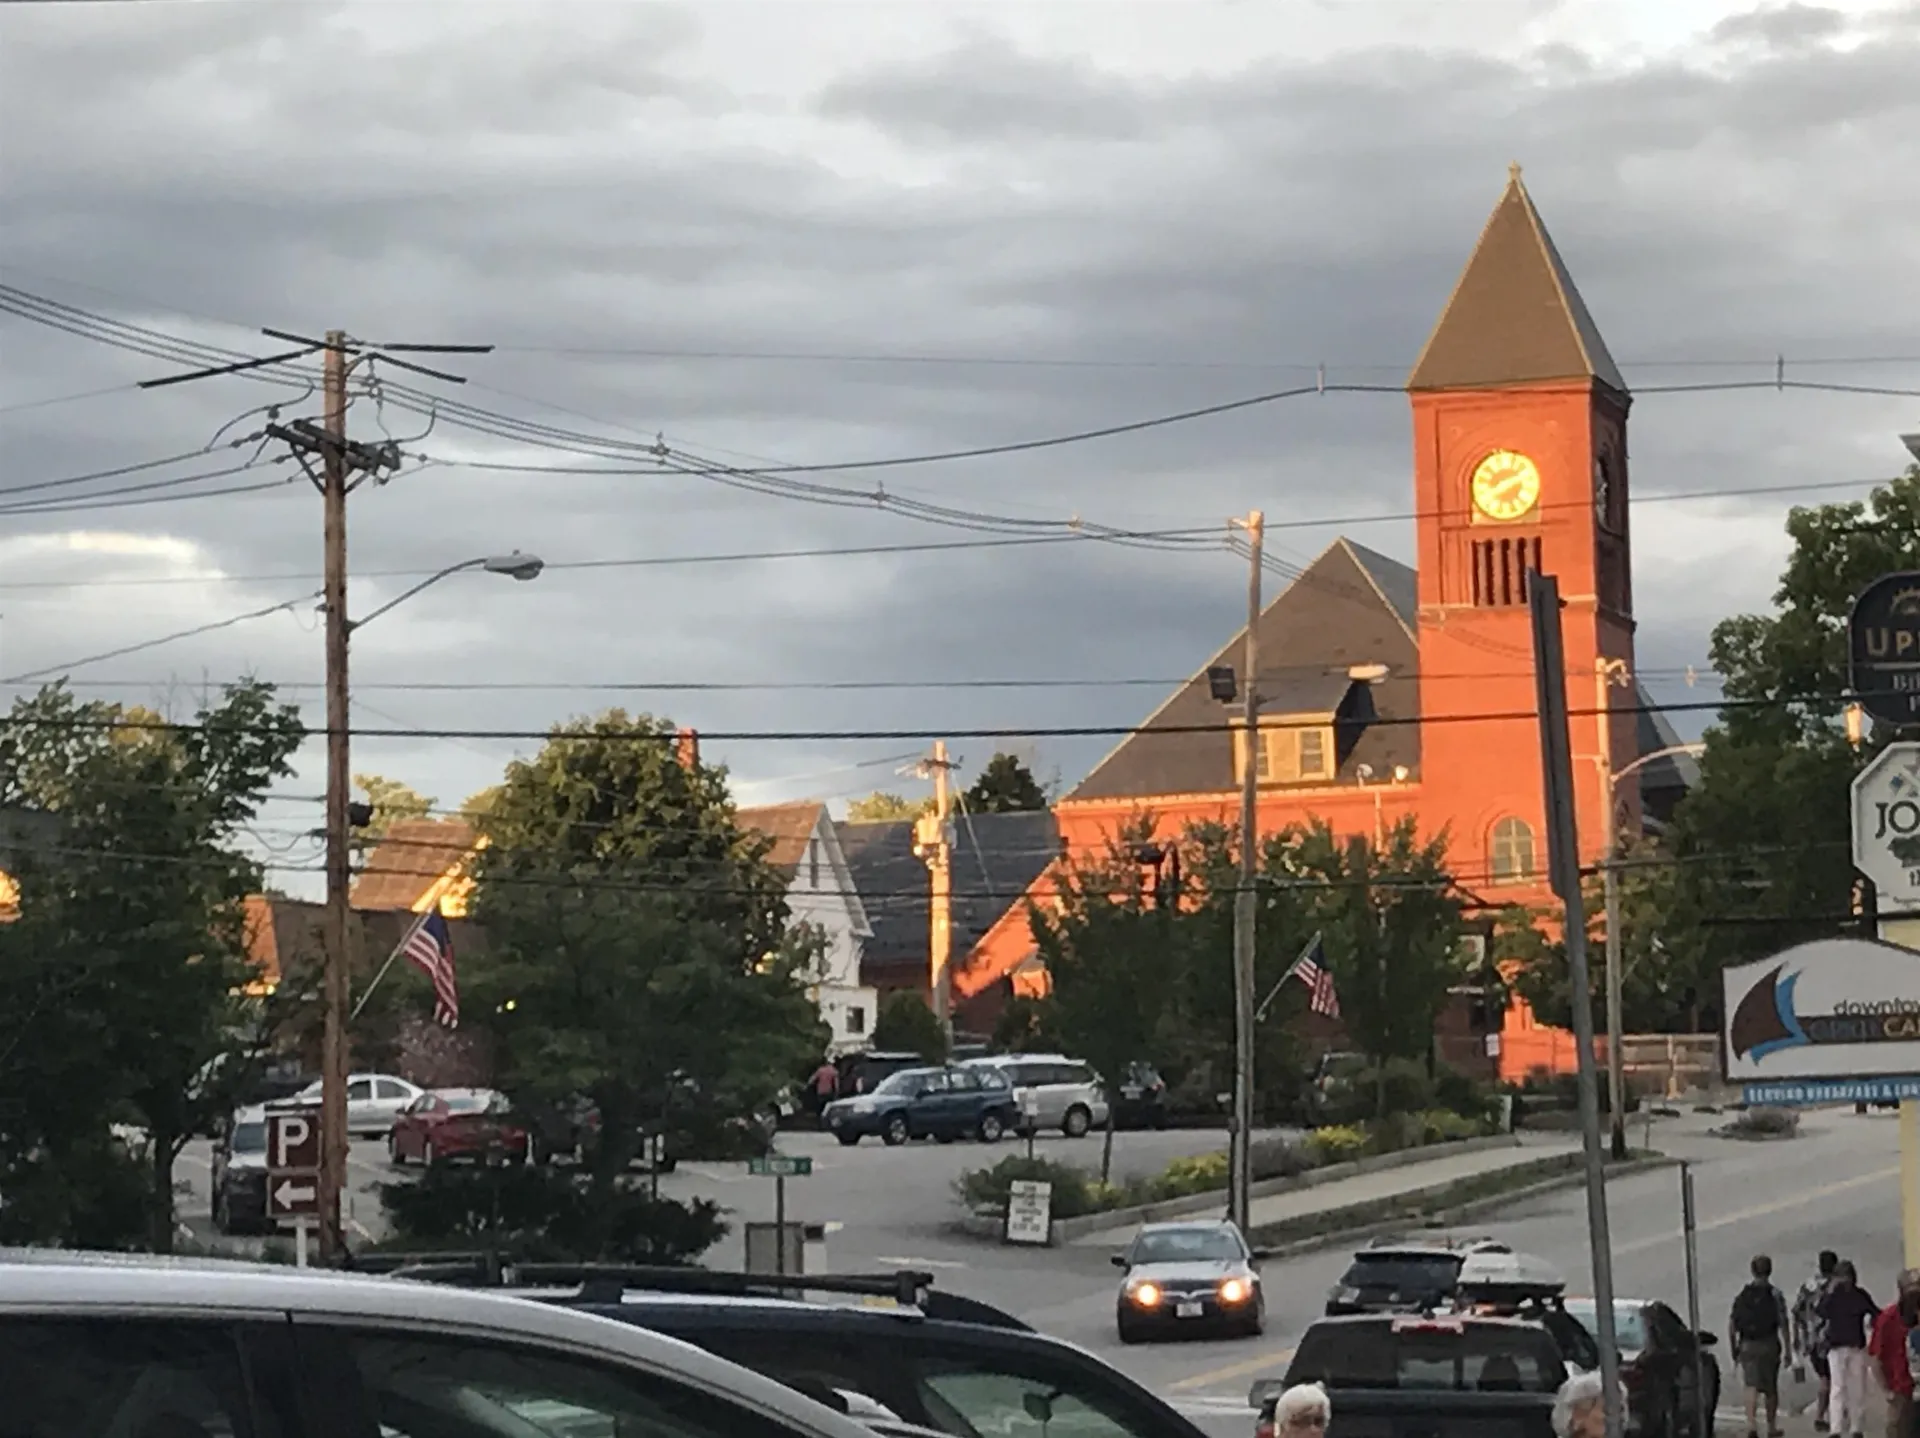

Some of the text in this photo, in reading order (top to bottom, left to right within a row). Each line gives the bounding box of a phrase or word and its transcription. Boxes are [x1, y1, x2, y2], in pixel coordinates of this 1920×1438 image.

[1865, 627, 1920, 657] UP
[1883, 1016, 1920, 1039] CA
[277, 1117, 310, 1167] P
